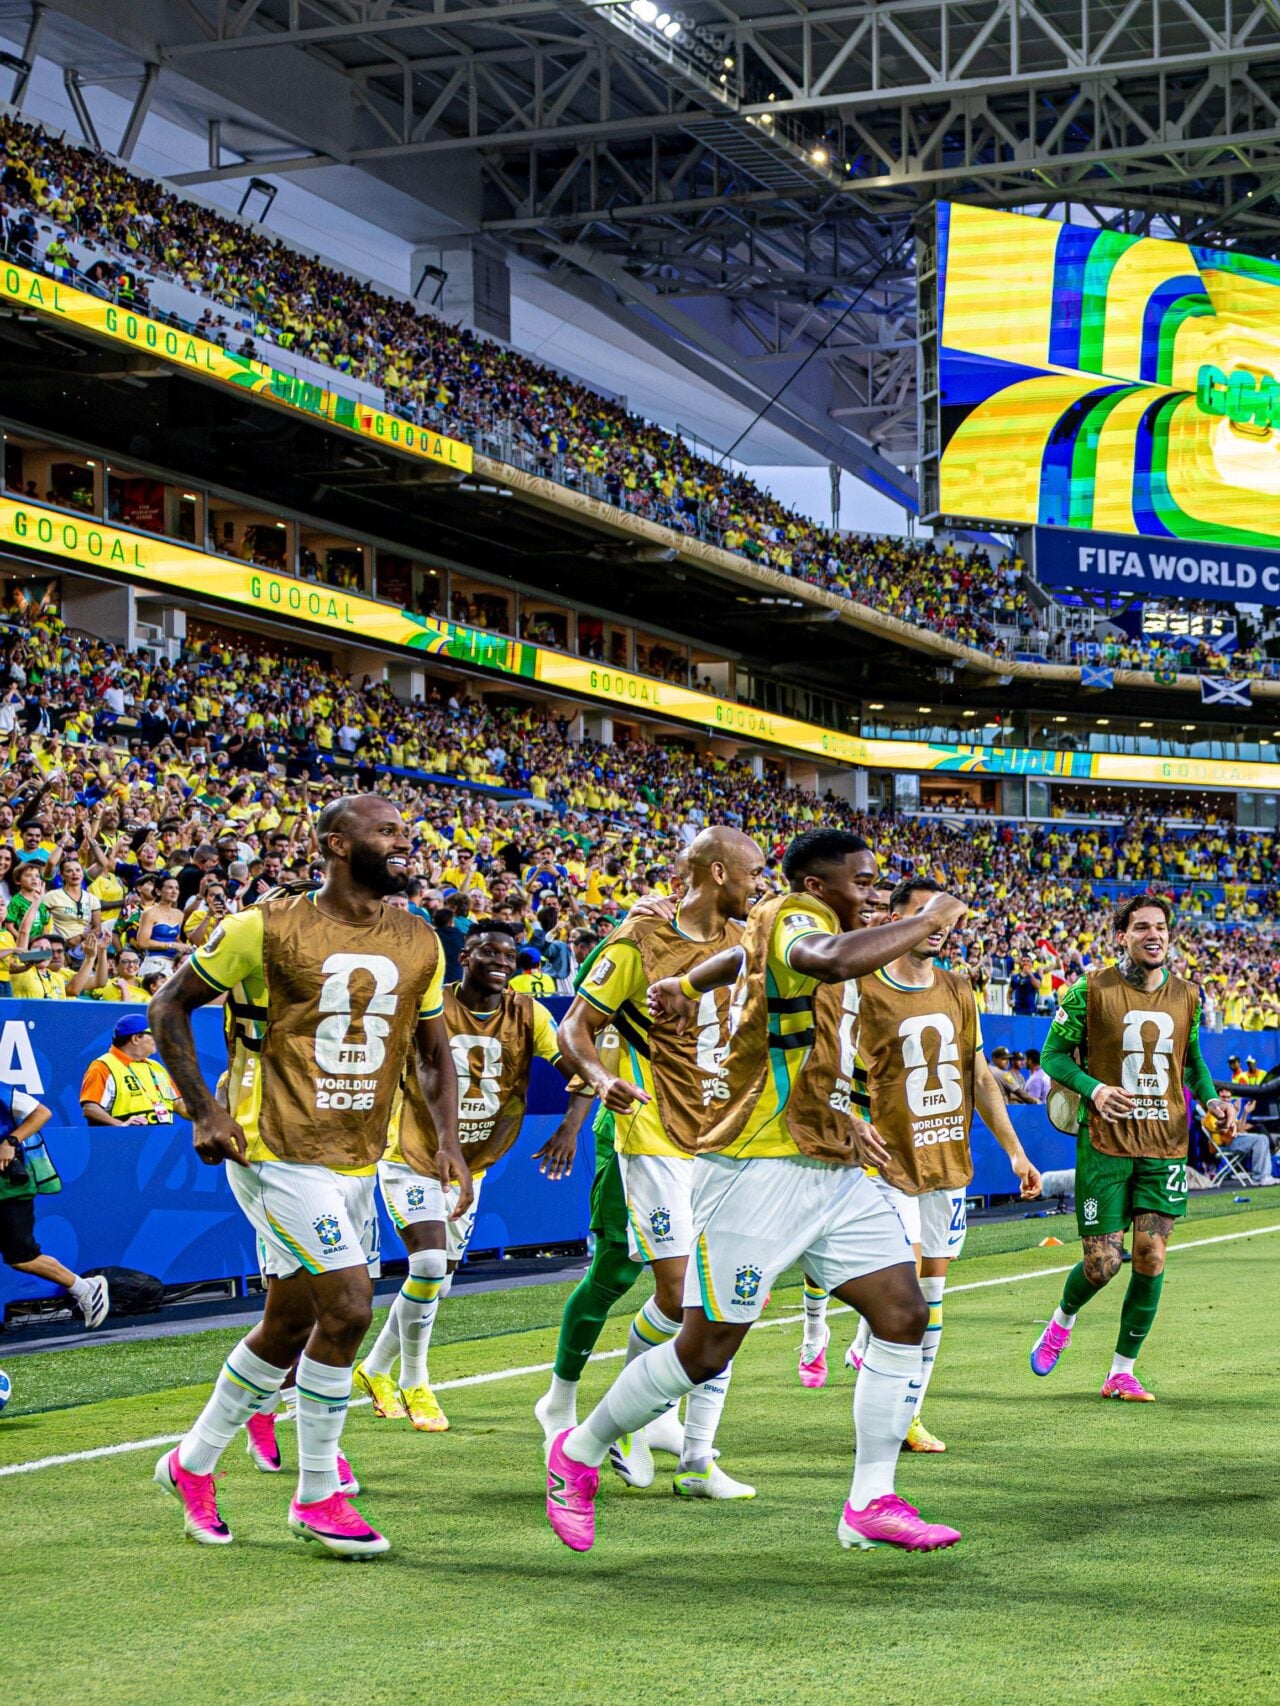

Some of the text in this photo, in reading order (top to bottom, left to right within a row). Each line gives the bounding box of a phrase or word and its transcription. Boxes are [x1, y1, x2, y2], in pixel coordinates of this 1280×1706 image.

[106, 307, 216, 371] GOOOAL
[375, 414, 457, 464] GOOOAL
[14, 511, 146, 569] GOOOAL
[1079, 547, 1144, 577] FIFA
[1148, 554, 1257, 589] WORLD
[251, 576, 355, 624] GOOOAL
[590, 670, 661, 705] GOOOAL
[716, 705, 775, 736] GOOOAL
[822, 734, 868, 758] GOOOA
[339, 1050, 366, 1063] FIFA
[316, 1077, 362, 1091] WORLD
[1137, 1078, 1159, 1088] FIFA
[316, 1092, 374, 1110] 2026
[461, 1102, 486, 1111] FIFA
[923, 1094, 947, 1107] FIFA
[1131, 1099, 1153, 1107] ORLD
[459, 1121, 495, 1130] RLD CUP
[911, 1115, 964, 1132] WORLD CUP
[458, 1129, 492, 1143] 026
[913, 1126, 964, 1148] 2026
[323, 1245, 348, 1255] BRASIL
